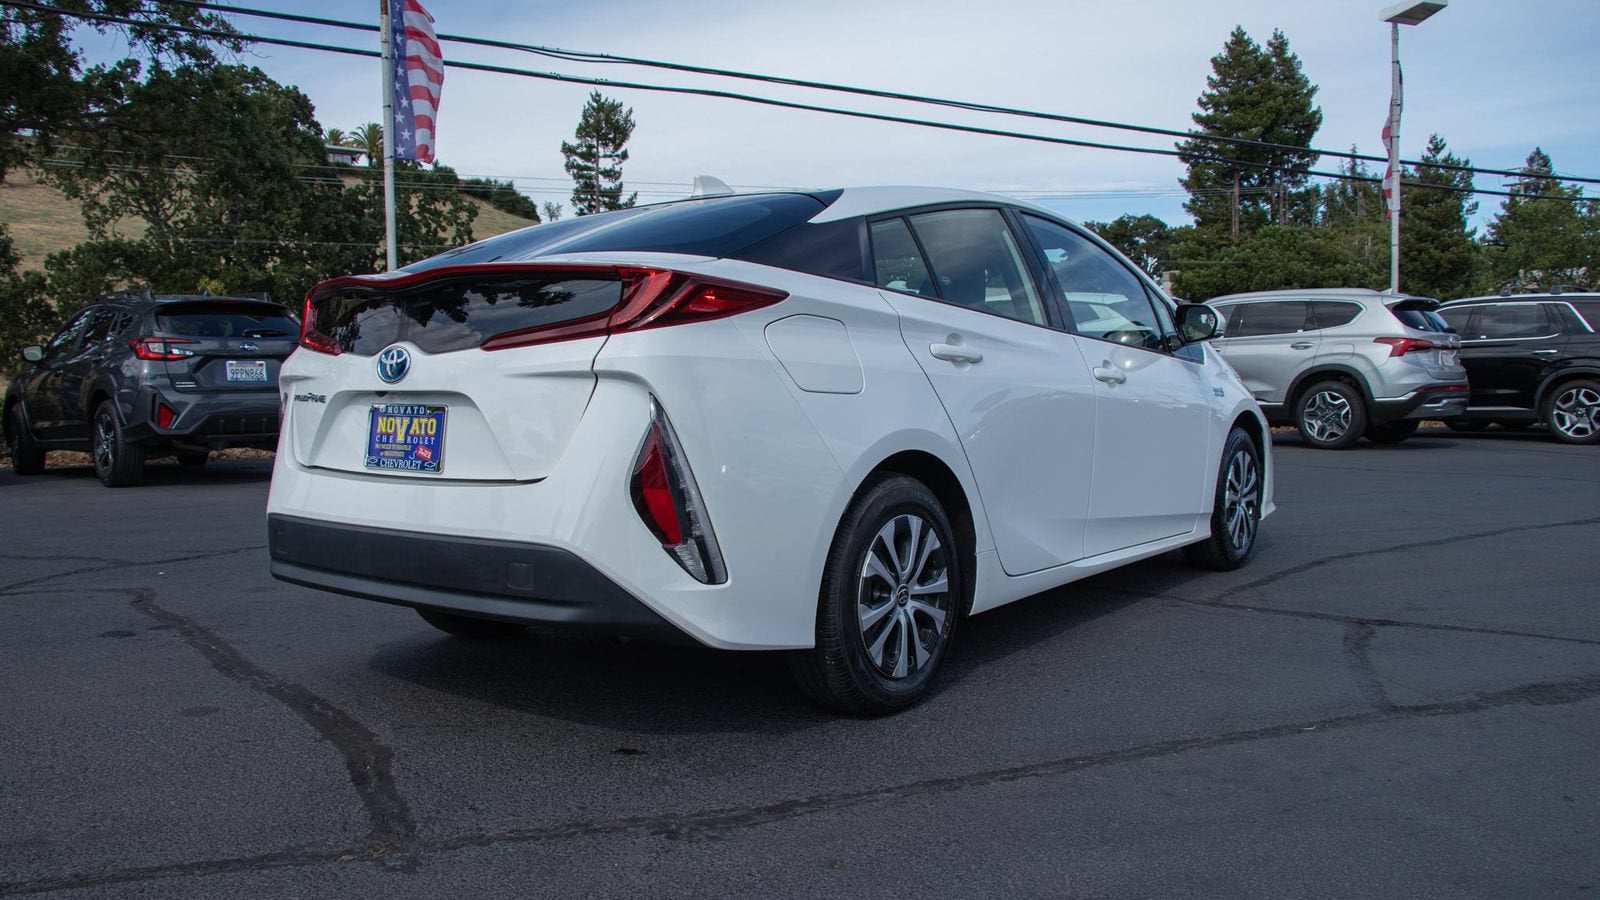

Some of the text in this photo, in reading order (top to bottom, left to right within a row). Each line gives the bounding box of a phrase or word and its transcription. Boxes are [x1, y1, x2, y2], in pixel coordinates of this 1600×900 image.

[387, 406, 425, 414] NOVATO
[377, 416, 437, 442] NOVATO
[380, 458, 422, 470] CHEVROLET
